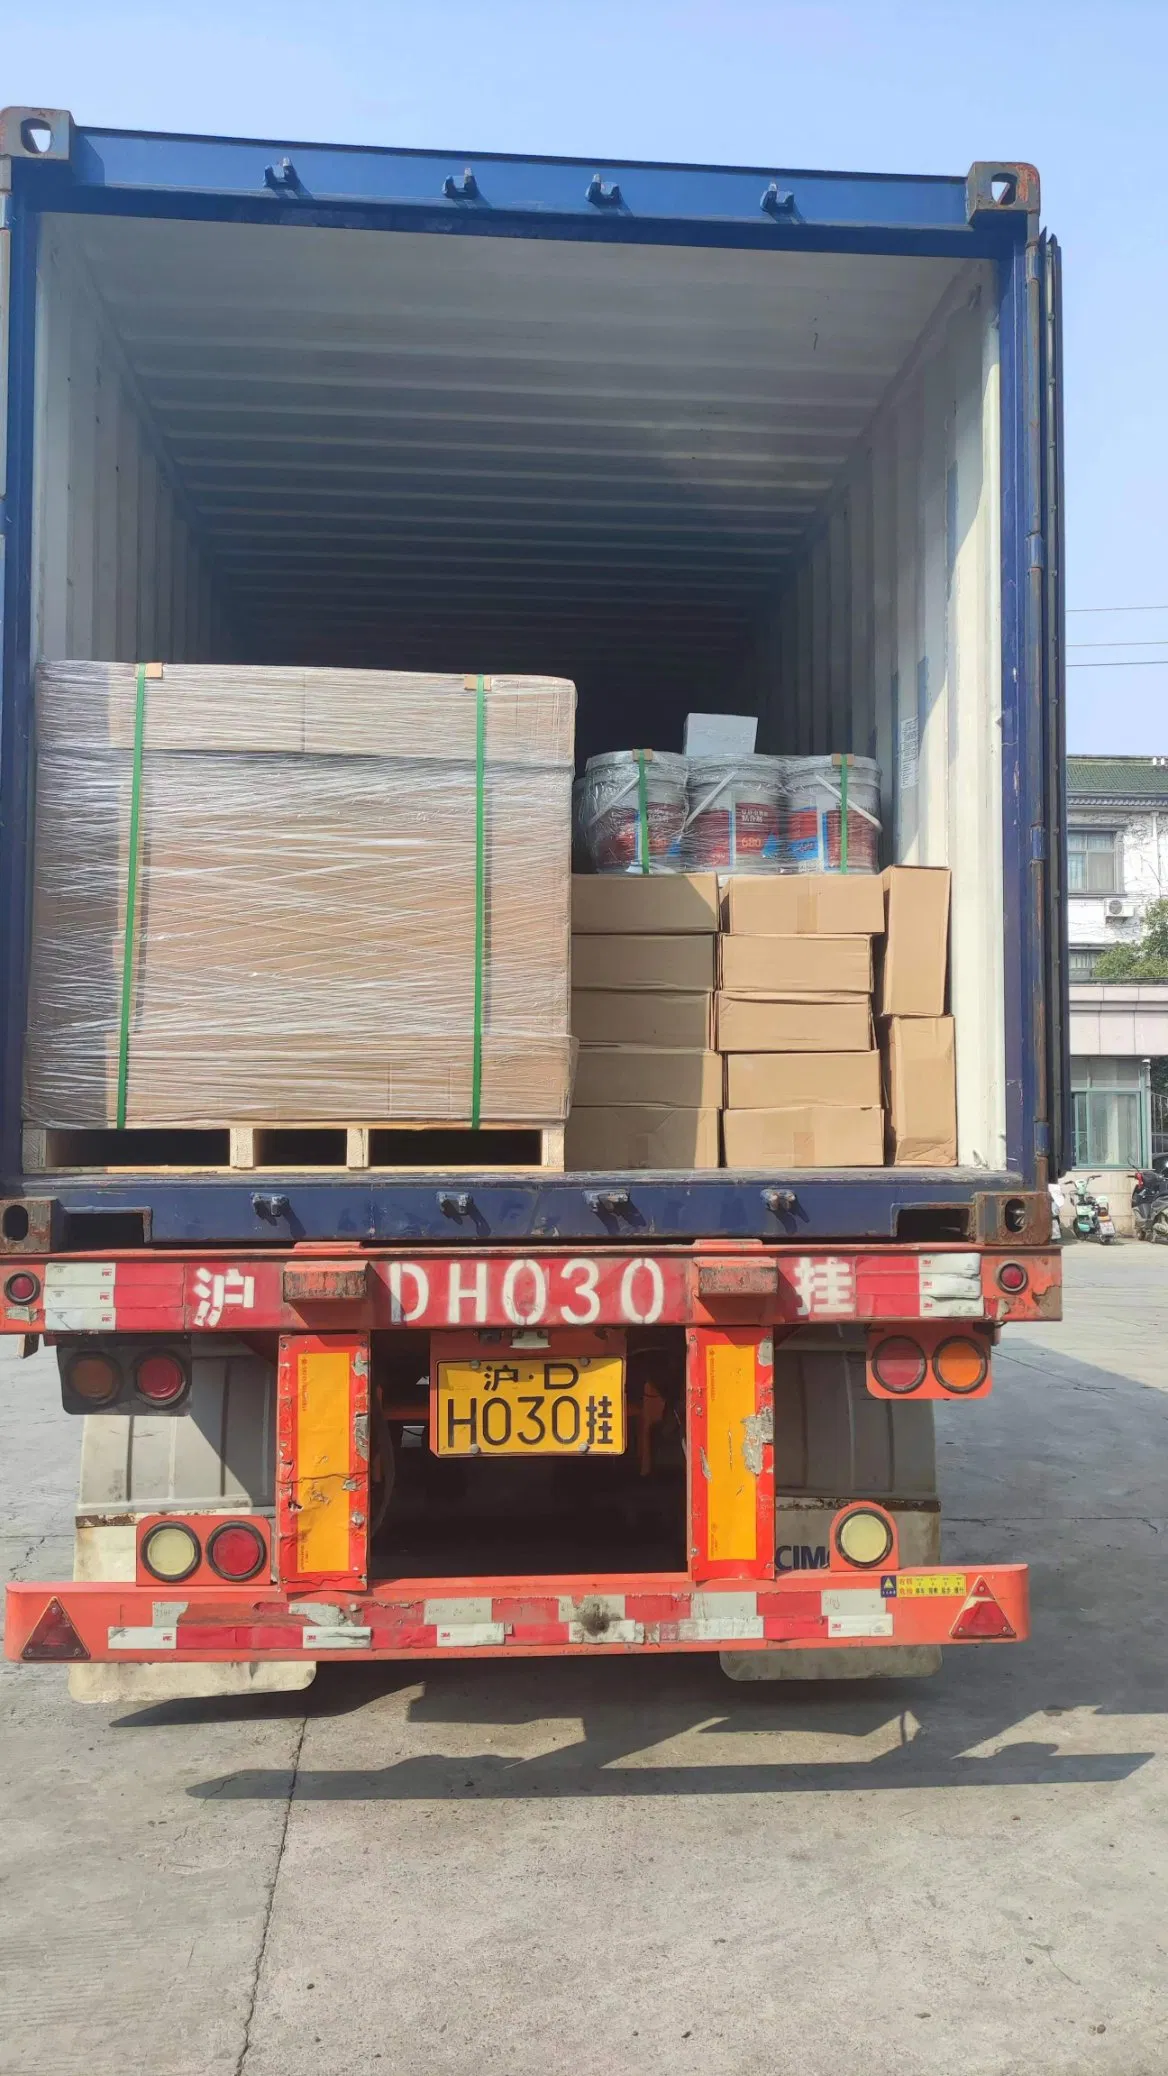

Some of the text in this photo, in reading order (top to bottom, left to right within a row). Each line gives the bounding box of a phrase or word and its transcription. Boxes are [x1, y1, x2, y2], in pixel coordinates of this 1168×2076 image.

[741, 837, 762, 848] 680
[193, 1256, 856, 1328] 沪 DH030 挂
[447, 1395, 613, 1448] H030挂
[775, 1545, 830, 1571] CIM
